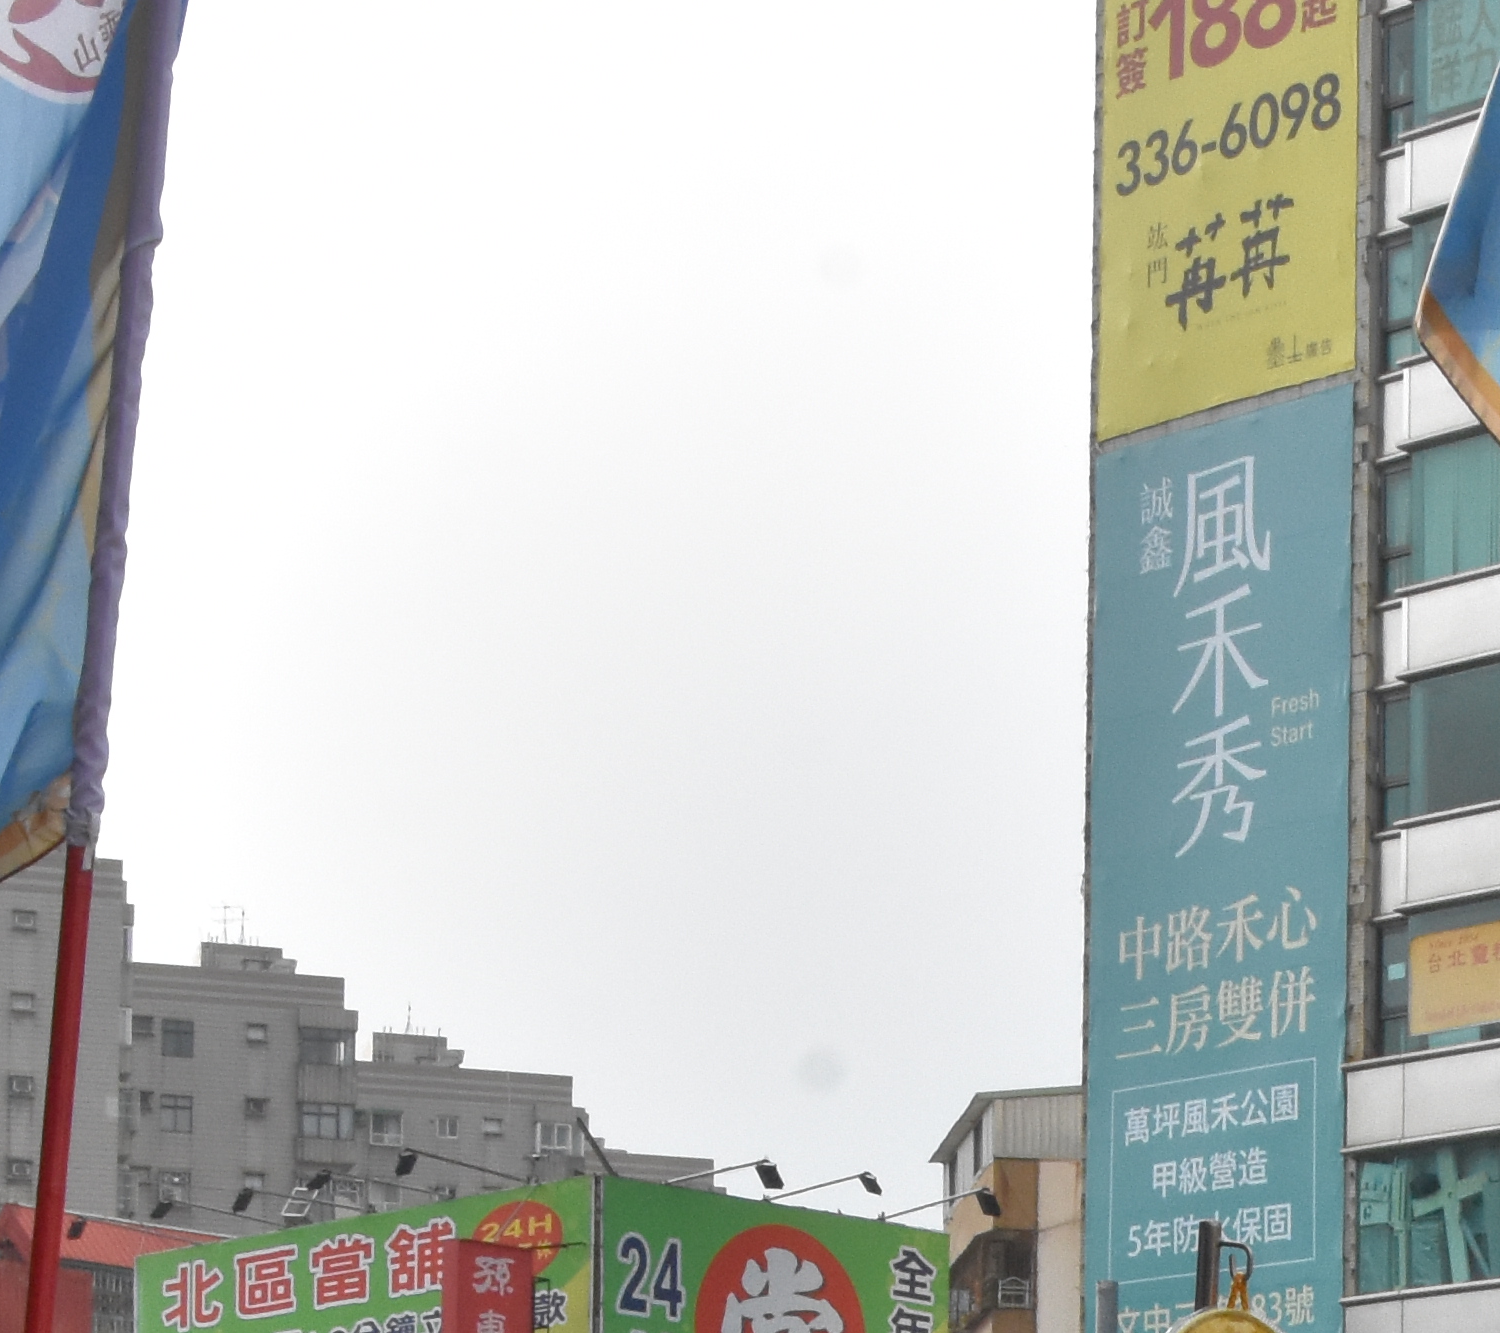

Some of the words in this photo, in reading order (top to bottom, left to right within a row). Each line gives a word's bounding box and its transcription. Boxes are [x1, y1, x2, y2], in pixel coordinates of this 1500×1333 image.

[1116, 72, 1342, 197] 336-6098
[1139, 477, 1173, 576] 誠鑫
[1171, 455, 1271, 858] 風禾秀
[1269, 688, 1320, 717] Fresh
[1269, 719, 1316, 748] Start
[1117, 885, 1318, 983] 中路禾心
[1114, 967, 1317, 1061] 三房雙併
[1123, 1083, 1300, 1146] 萬坪風禾公園
[1151, 1146, 1269, 1200] 甲級營造
[161, 1216, 456, 1333] 北區當舖
[615, 1230, 684, 1319] 24
